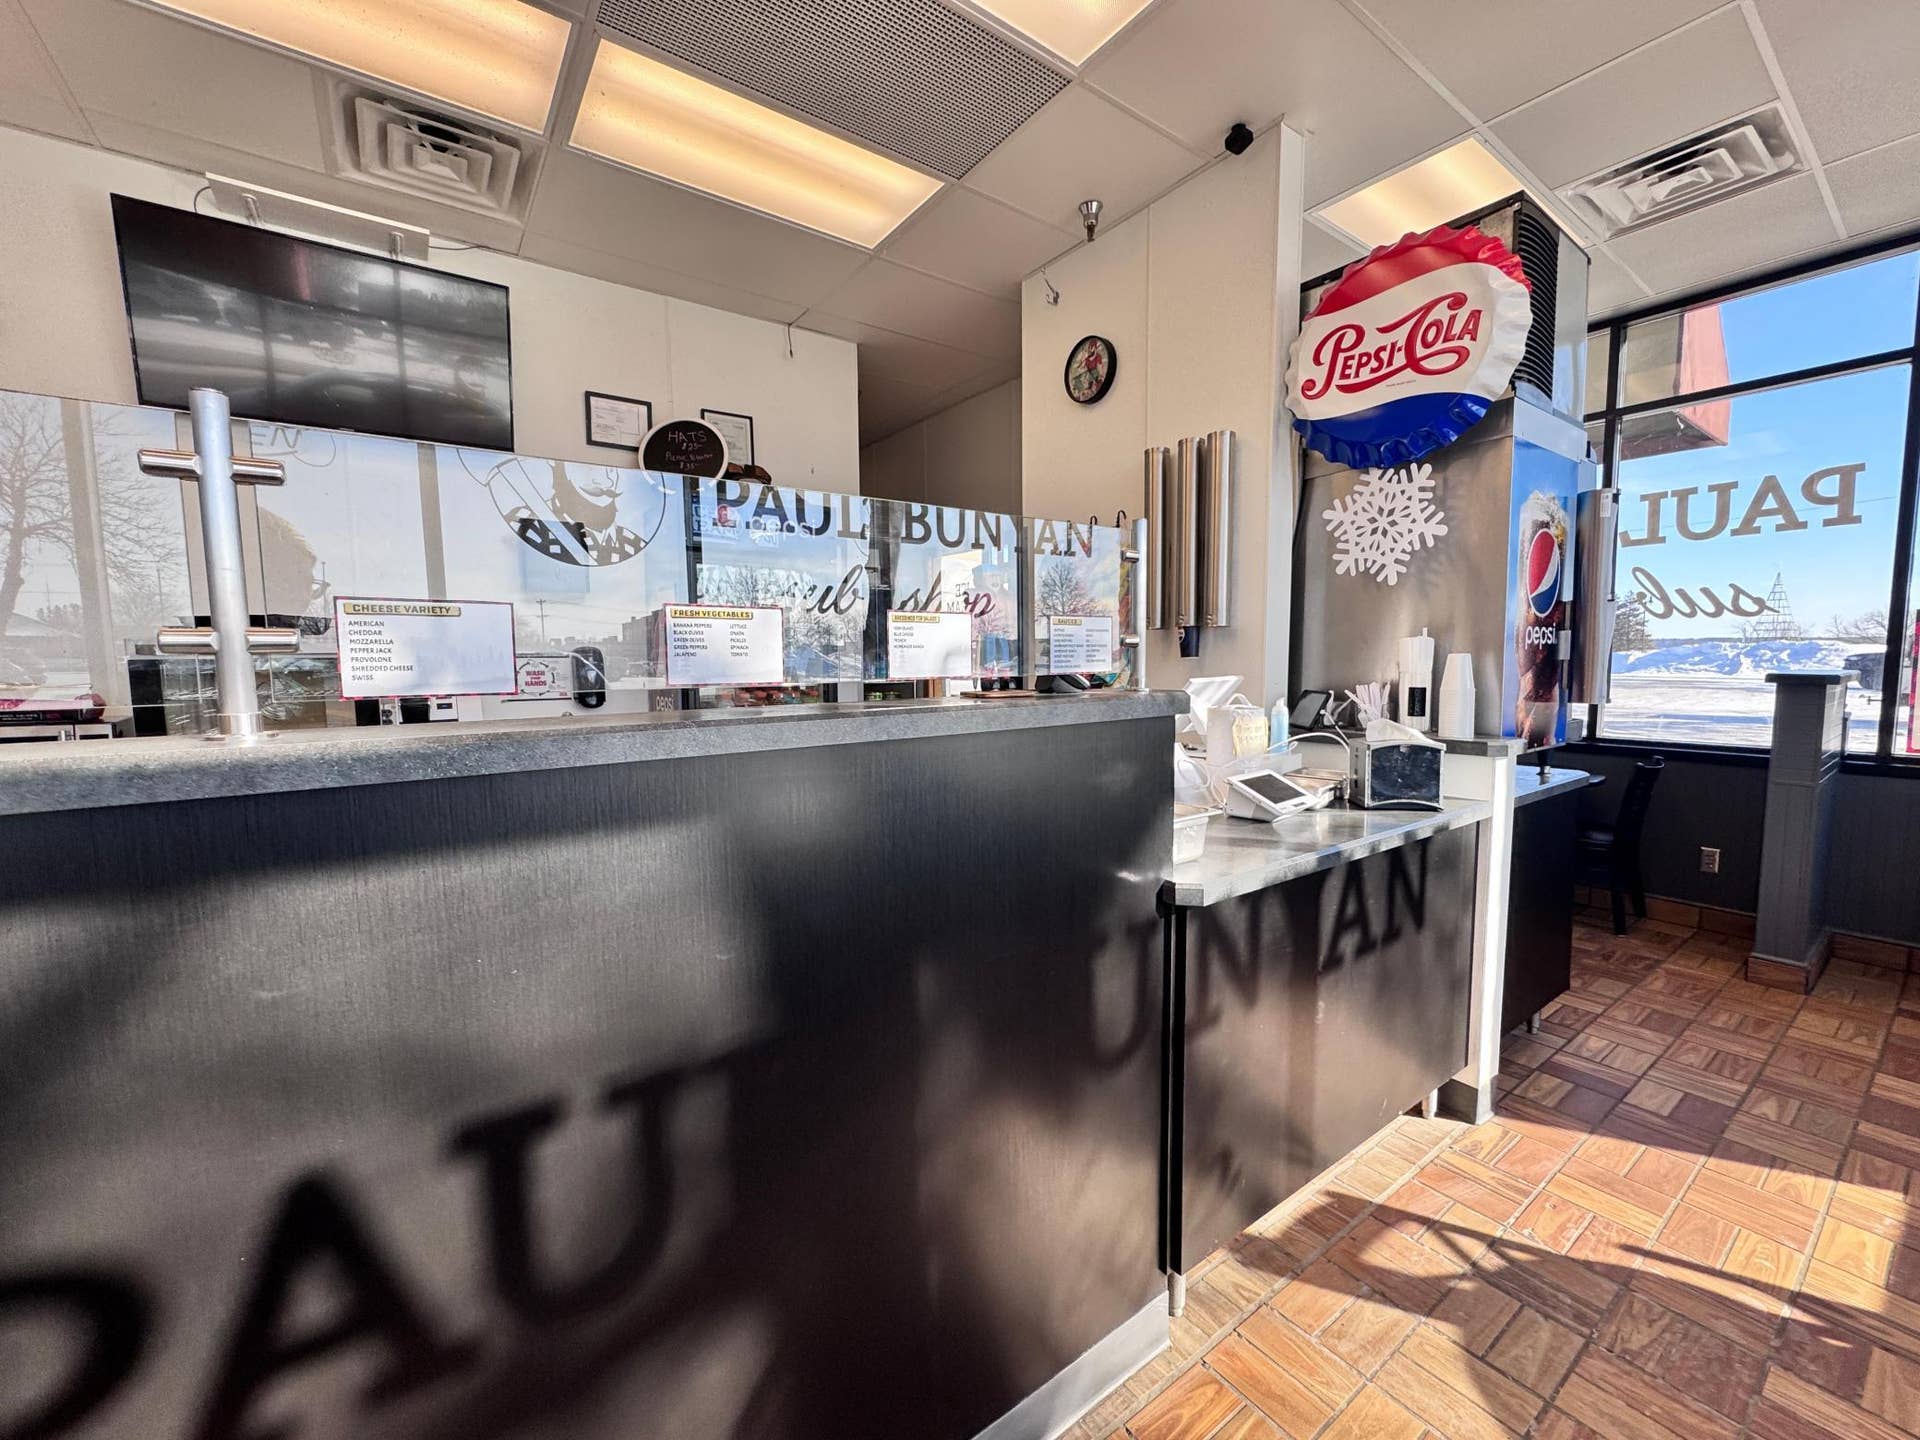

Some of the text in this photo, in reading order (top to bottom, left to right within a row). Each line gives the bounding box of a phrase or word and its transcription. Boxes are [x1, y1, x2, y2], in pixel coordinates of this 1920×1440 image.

[668, 430, 707, 443] HATS
[352, 604, 452, 615] CHEESE VARIETY
[673, 609, 750, 618] FRESH VEGETABLES
[1525, 622, 1557, 650] pepsi
